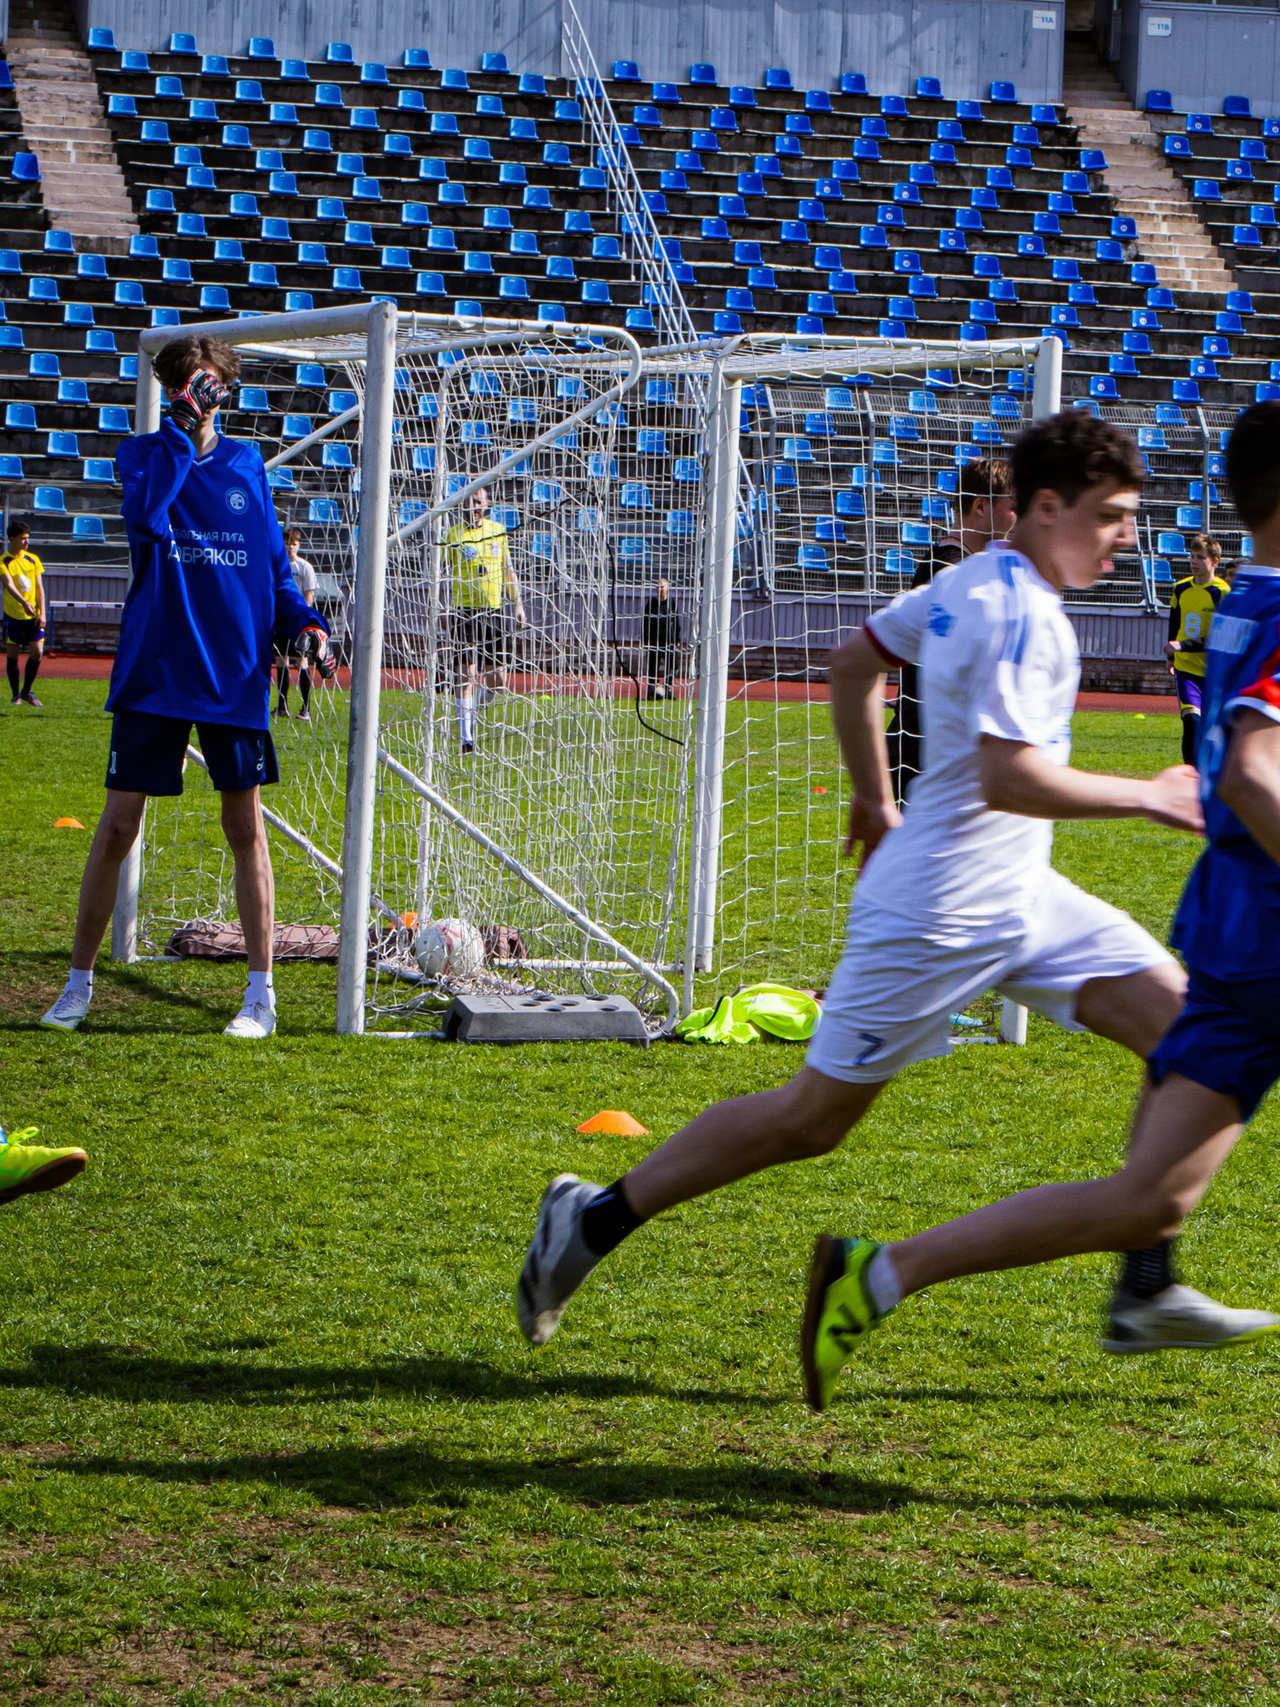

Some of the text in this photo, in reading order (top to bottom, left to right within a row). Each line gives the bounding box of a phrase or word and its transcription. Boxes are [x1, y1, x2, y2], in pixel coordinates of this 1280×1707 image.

[1041, 16, 1053, 24] 11A
[221, 532, 245, 543] ЛИГА
[1185, 613, 1201, 638] 8
